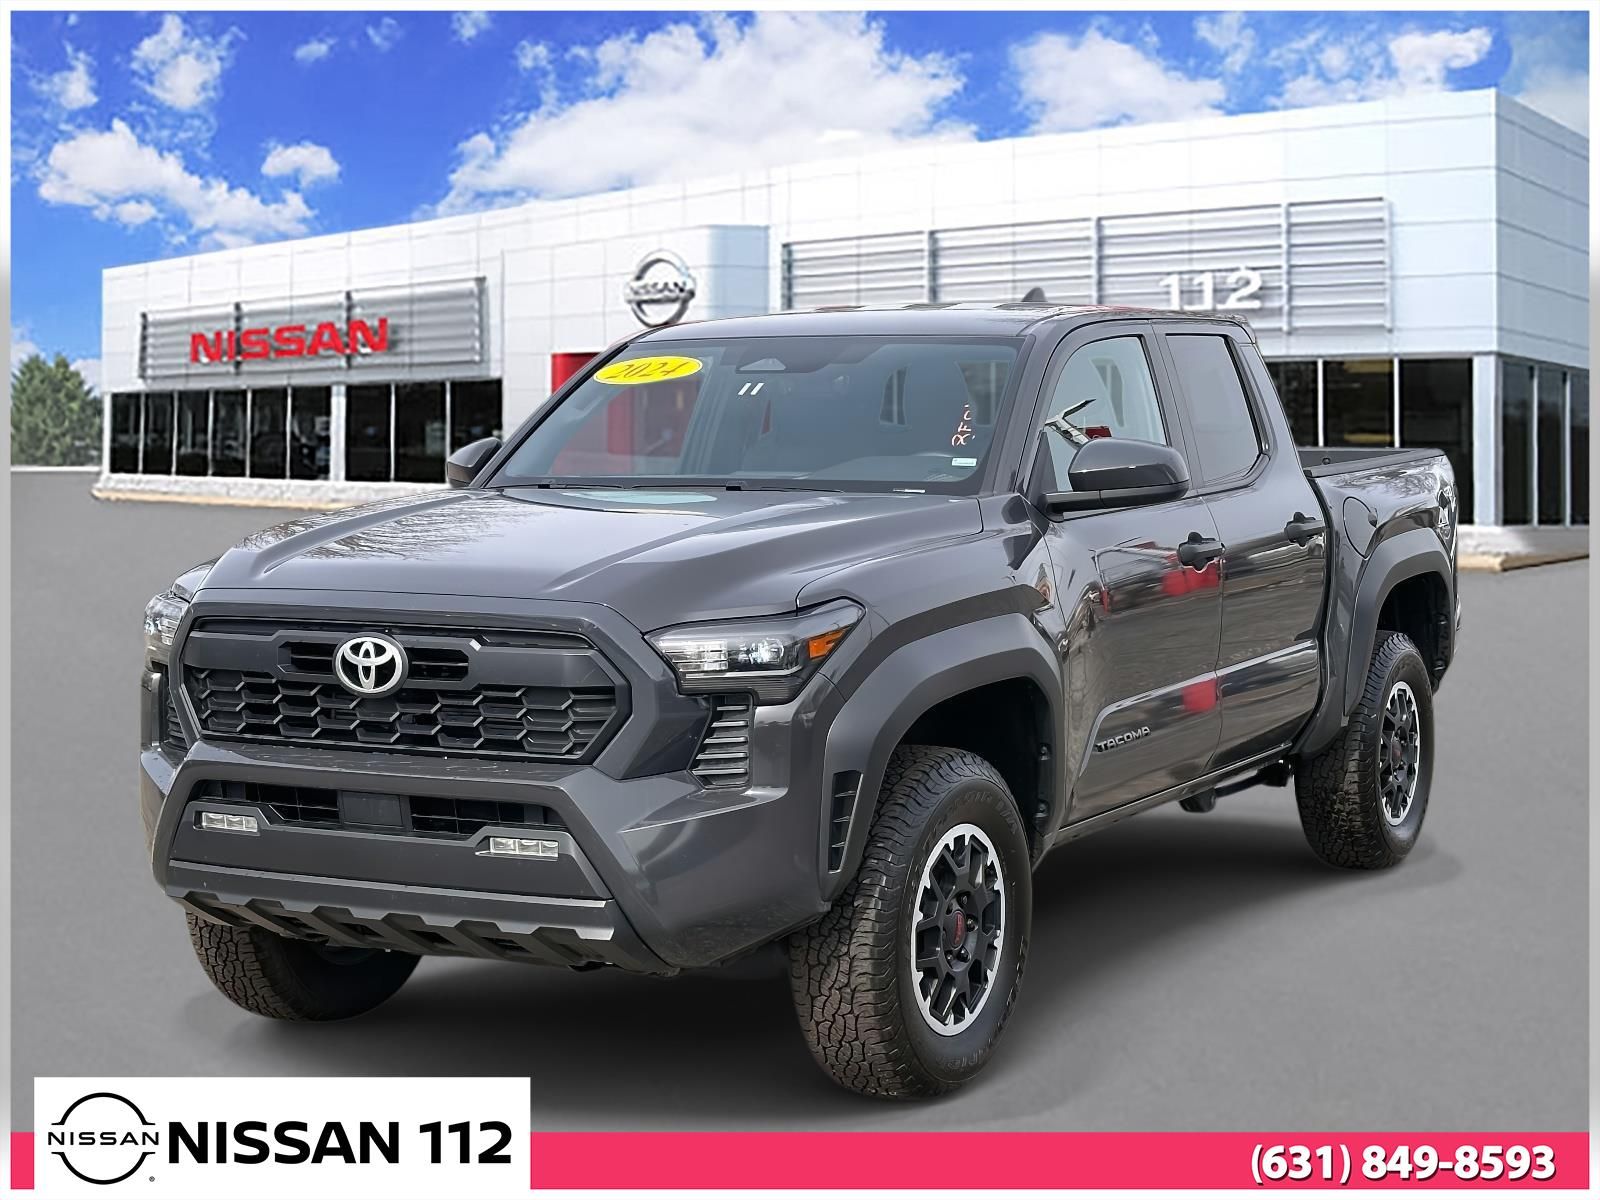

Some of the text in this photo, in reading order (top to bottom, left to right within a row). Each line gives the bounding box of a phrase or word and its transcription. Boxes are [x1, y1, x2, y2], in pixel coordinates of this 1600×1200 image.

[1159, 268, 1263, 311] 112
[191, 317, 388, 363] NISSAN
[1096, 726, 1151, 752] TACOMA
